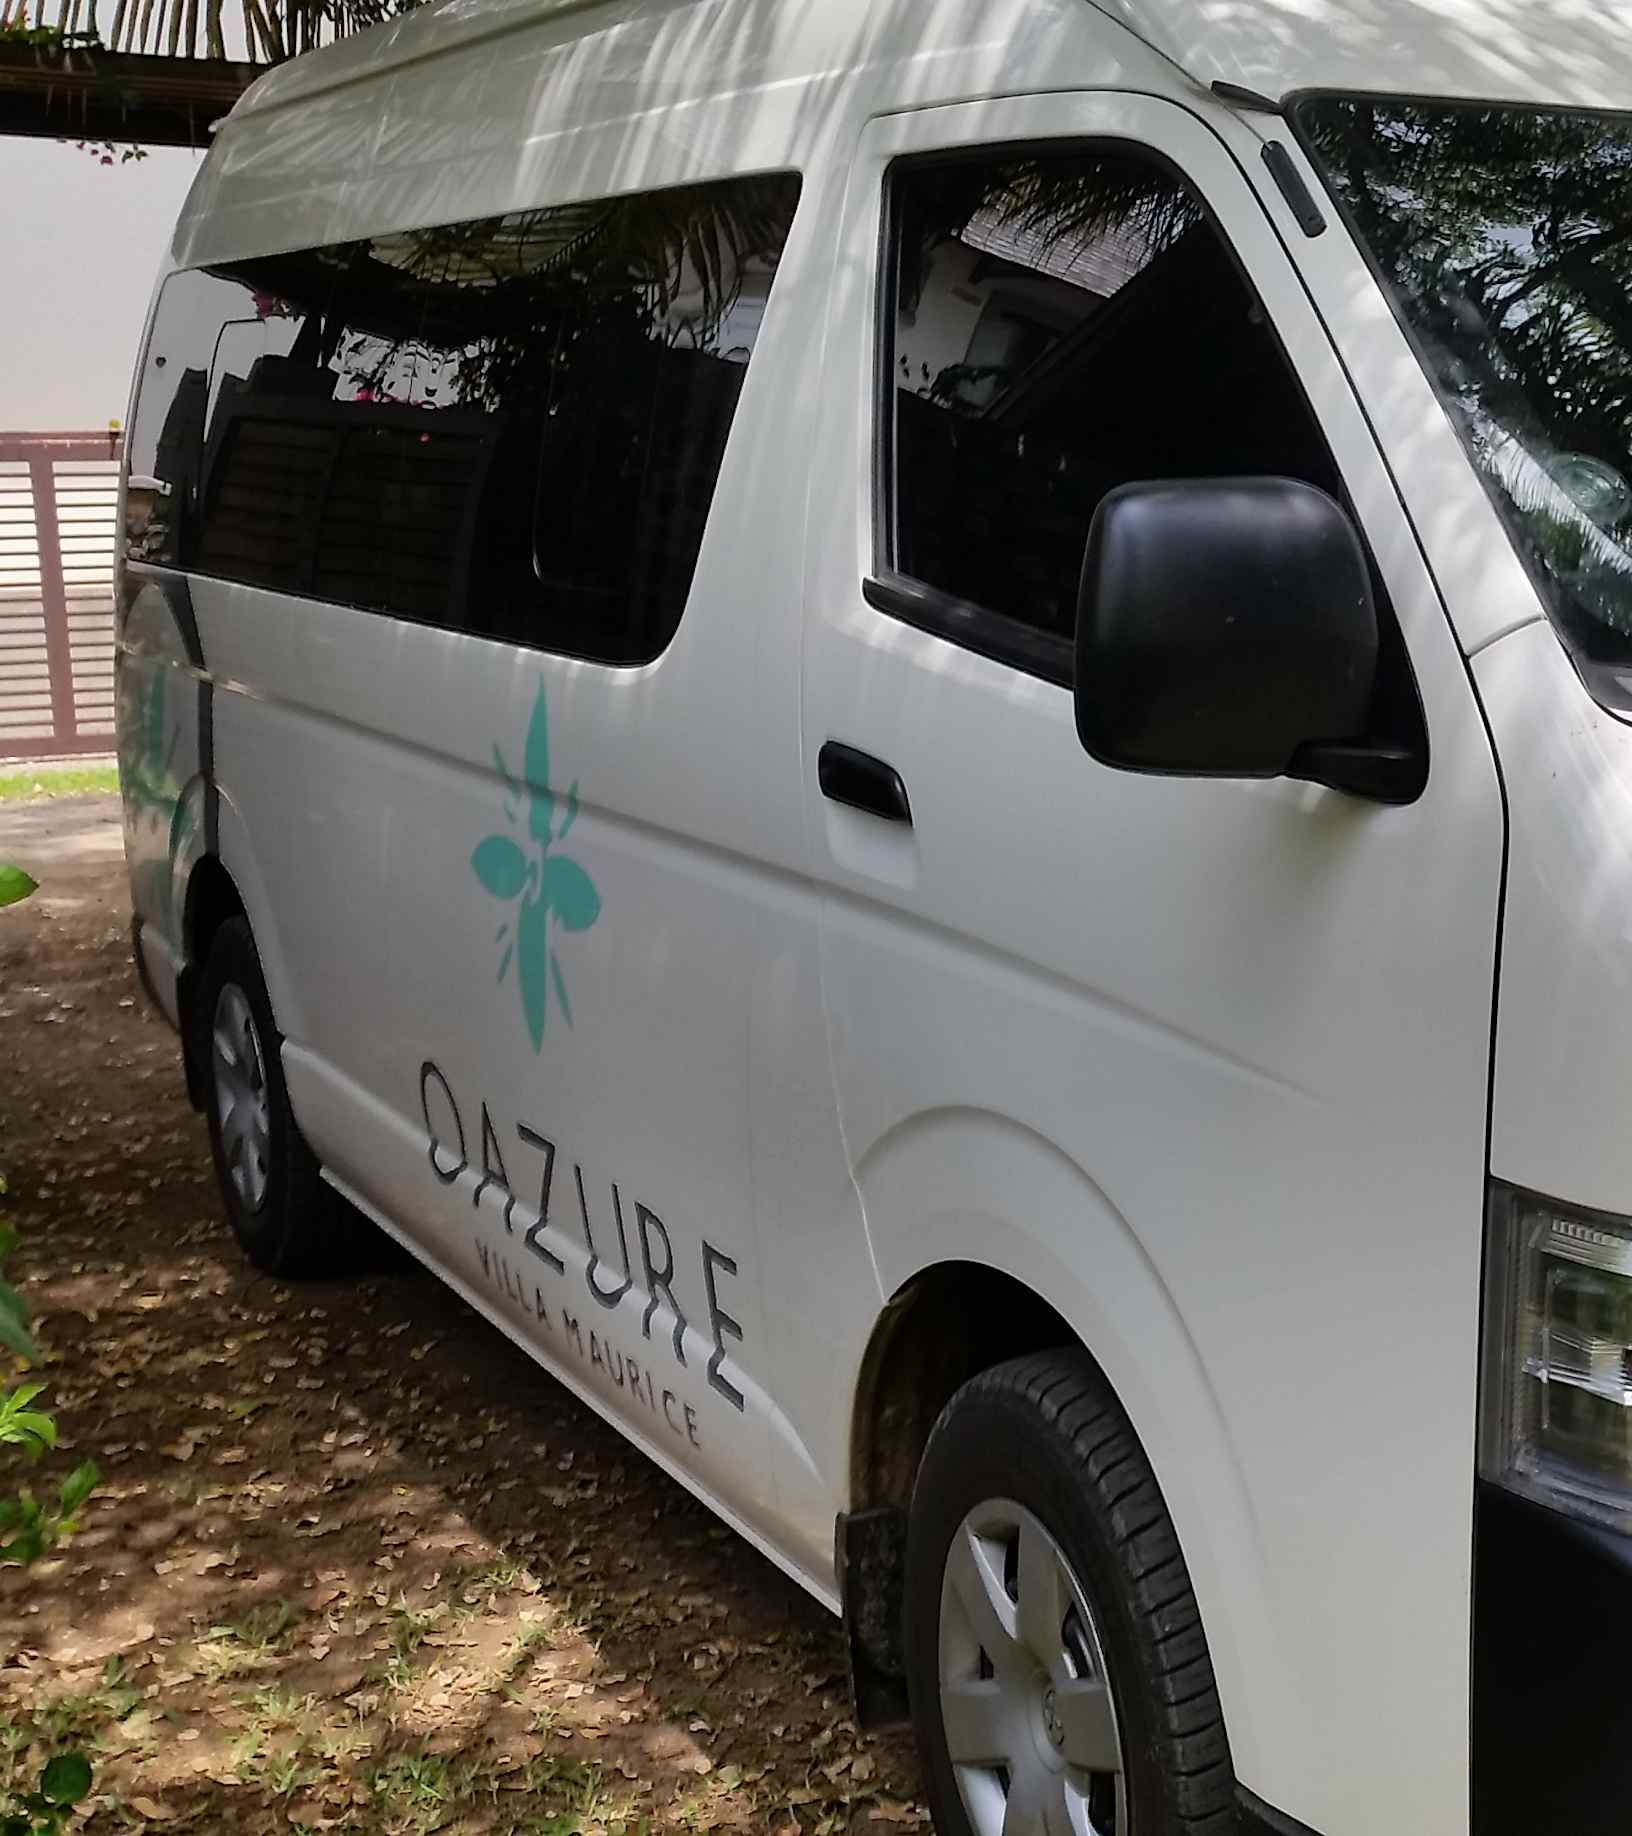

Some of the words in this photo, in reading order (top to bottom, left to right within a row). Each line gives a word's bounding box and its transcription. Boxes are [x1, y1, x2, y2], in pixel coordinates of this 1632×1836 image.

[420, 1060, 744, 1413] OAZURE
[475, 1237, 553, 1331] VILLA
[562, 1307, 702, 1451] MAURICE
